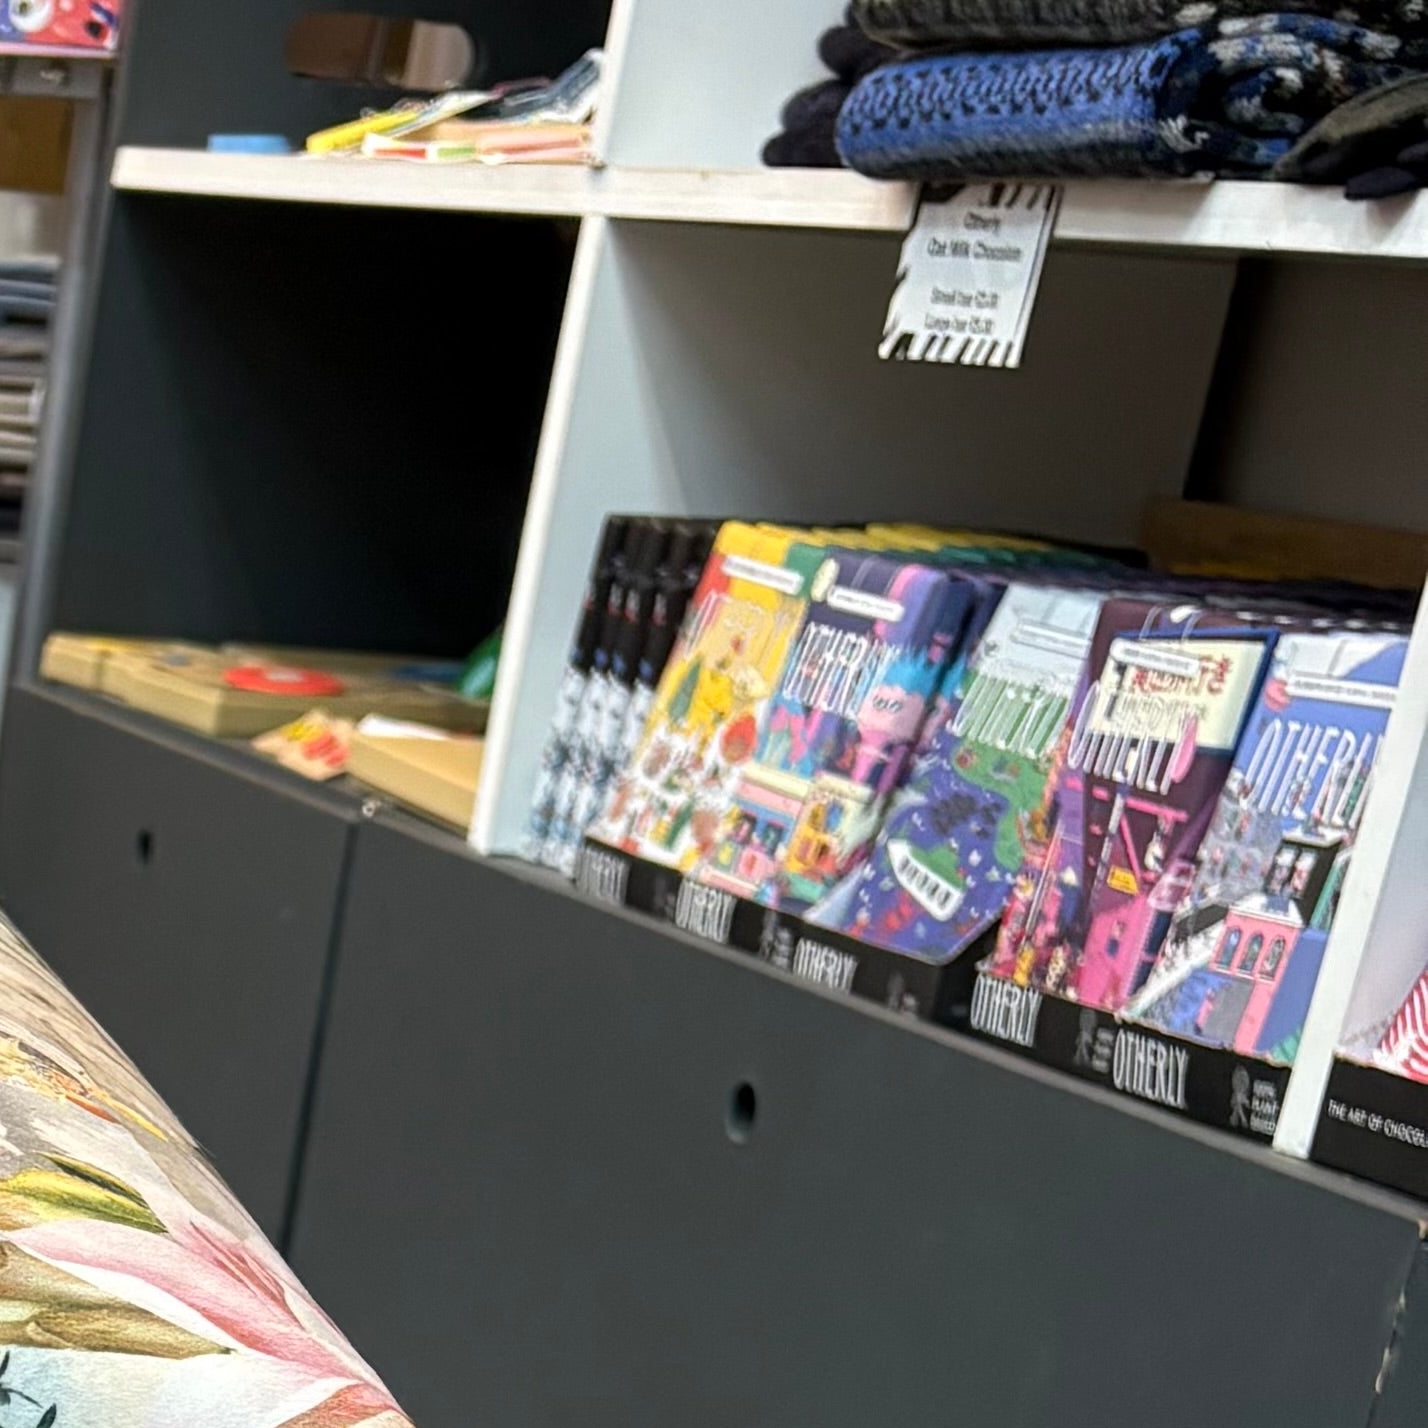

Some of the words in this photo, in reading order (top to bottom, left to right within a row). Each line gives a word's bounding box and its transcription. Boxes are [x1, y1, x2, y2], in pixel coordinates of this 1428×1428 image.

[674, 877, 737, 945] OTHERLY
[793, 936, 859, 996] OTHERLY
[970, 973, 1043, 1048] OTHERLY
[1112, 1027, 1189, 1110] OTHERLY
[1328, 1098, 1347, 1122] THE
[1347, 1106, 1368, 1128] ART
[1368, 1113, 1384, 1132] OF
[1384, 1118, 1428, 1149] CHOCOL
